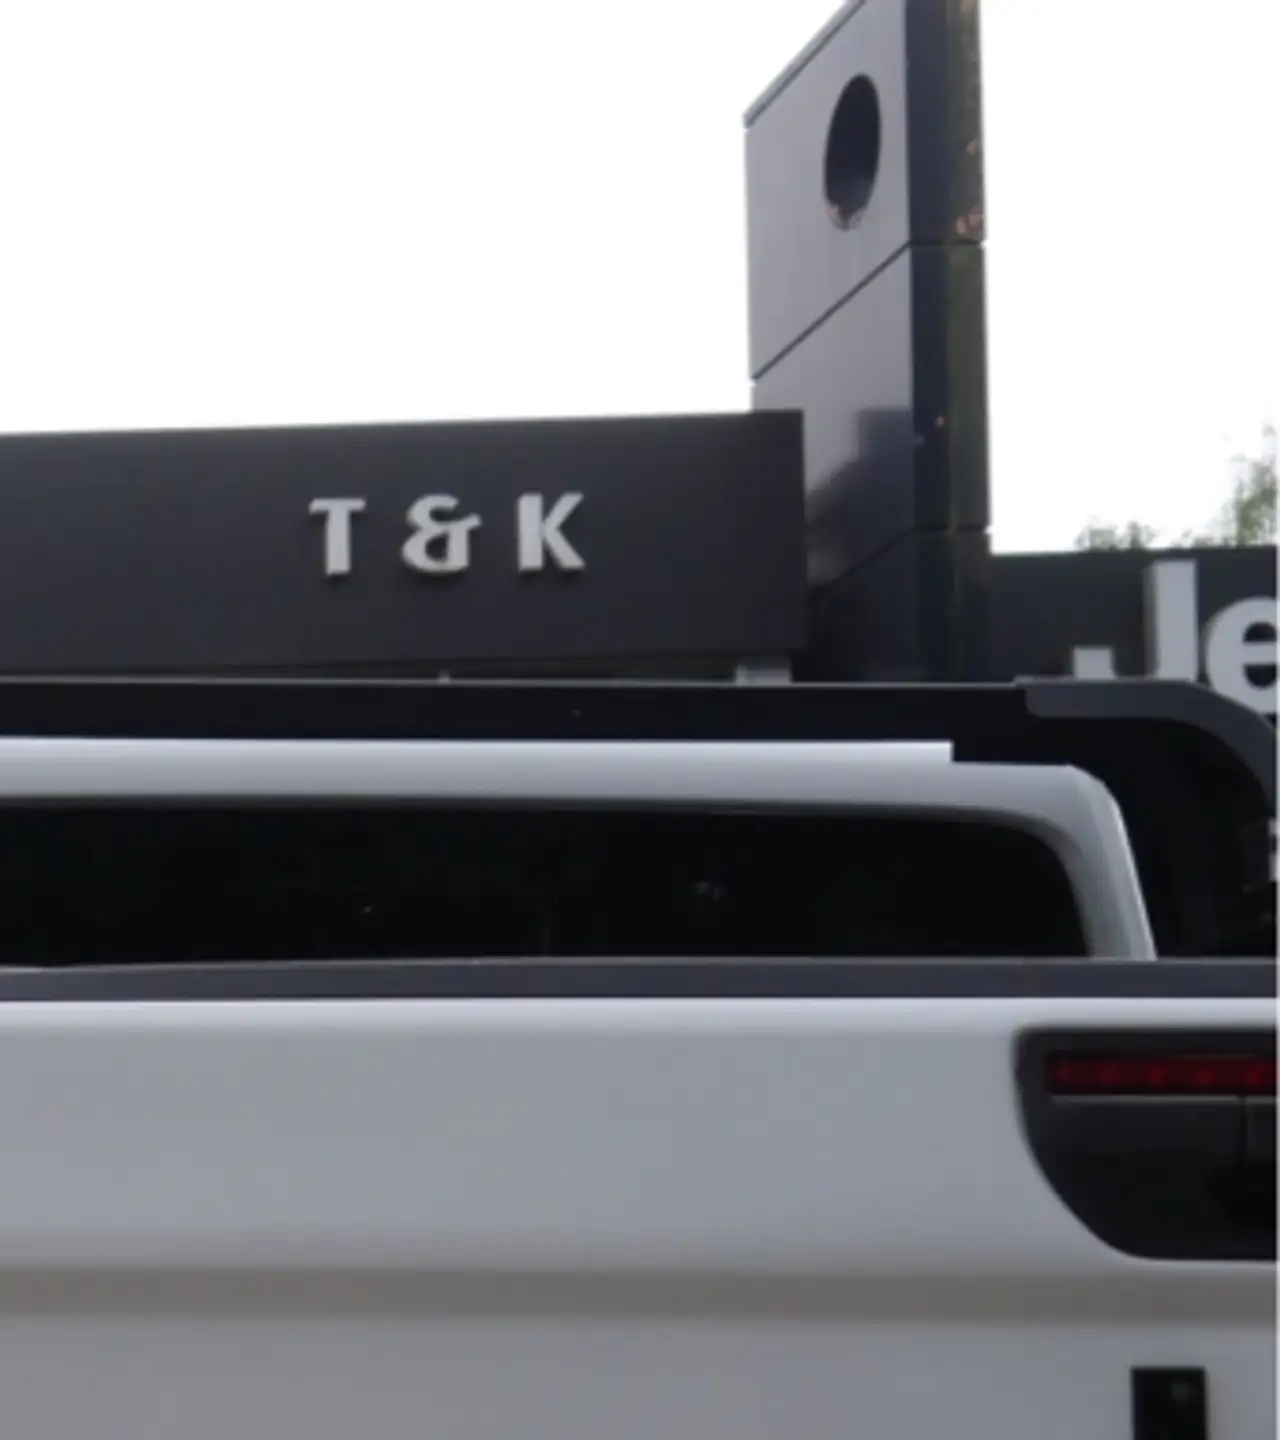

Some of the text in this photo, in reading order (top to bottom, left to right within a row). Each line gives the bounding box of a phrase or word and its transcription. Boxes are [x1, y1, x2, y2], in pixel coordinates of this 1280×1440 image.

[308, 492, 587, 576] T & K
